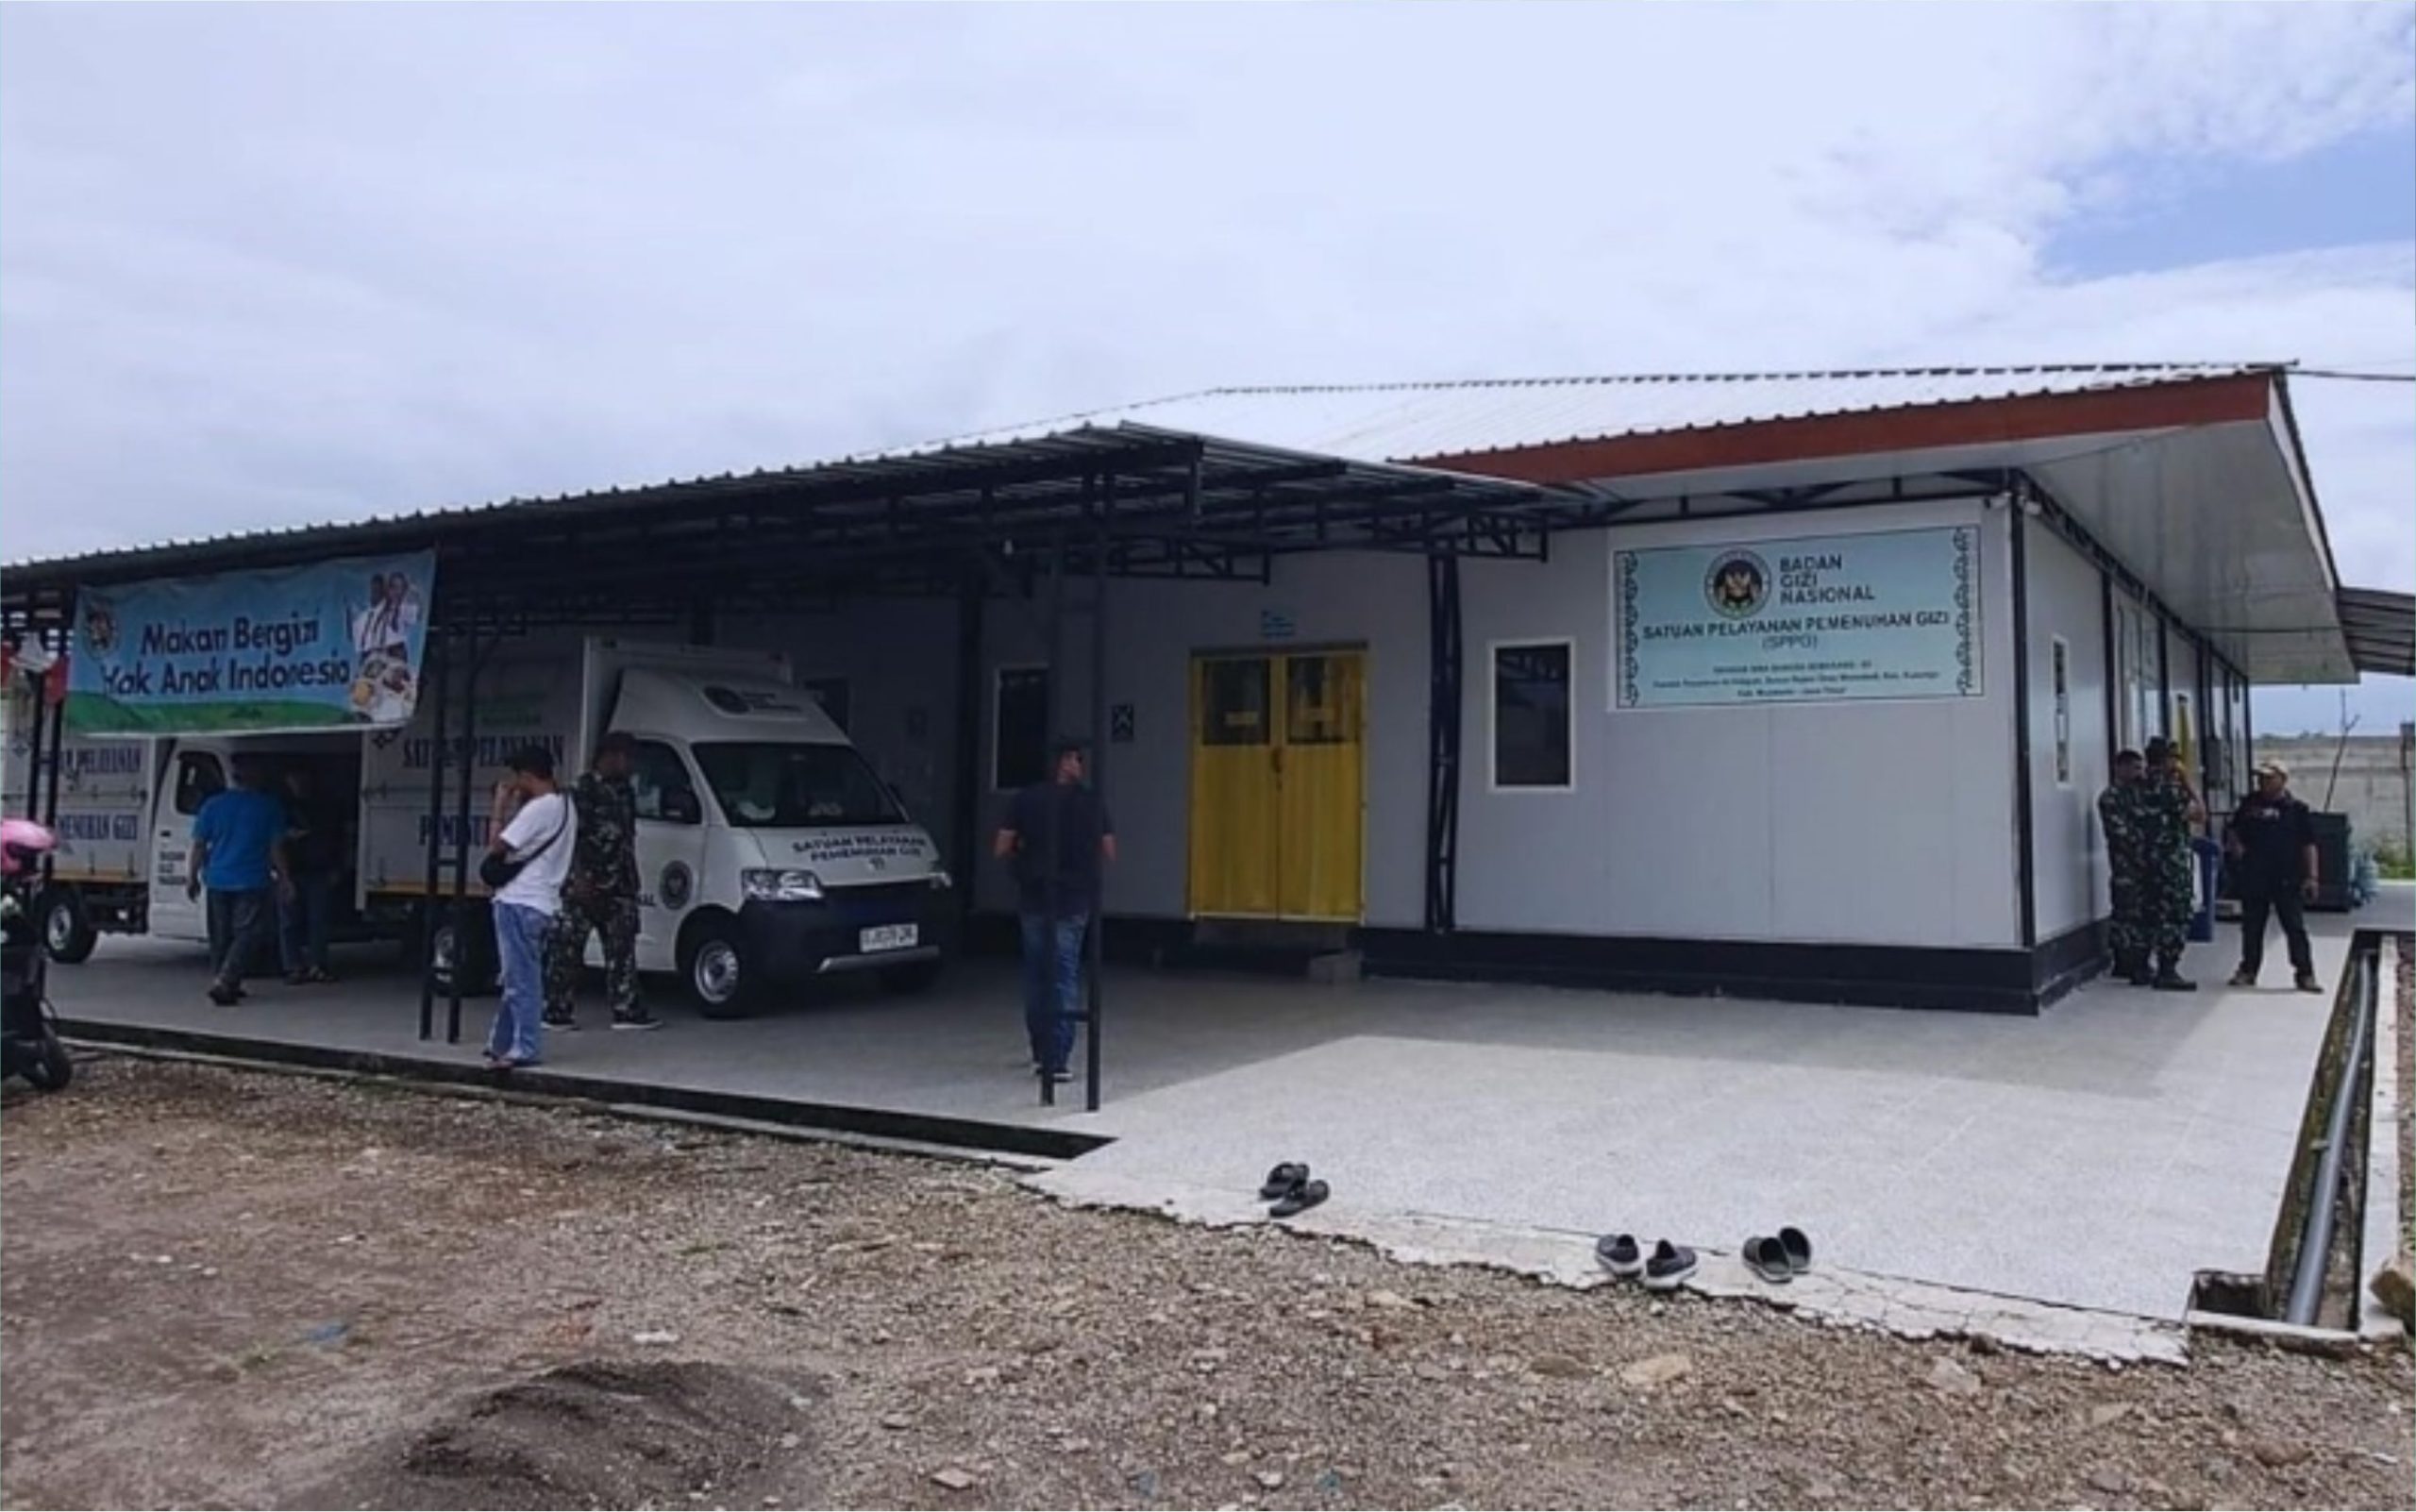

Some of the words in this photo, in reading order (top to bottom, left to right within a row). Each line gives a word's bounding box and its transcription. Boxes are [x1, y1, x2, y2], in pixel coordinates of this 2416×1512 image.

[1780, 554, 1842, 572] BADAN
[1780, 573, 1818, 588] GIZI
[1780, 585, 1875, 604] NASIONAL
[140, 619, 228, 656] Makan
[1643, 625, 1703, 640] SATUAN
[1707, 619, 1803, 637] PELAYANAN
[1806, 613, 1912, 631] PEMENUHAN
[1916, 612, 1950, 627] GIZI
[159, 656, 223, 694] Anak
[230, 648, 350, 691] Indonesia
